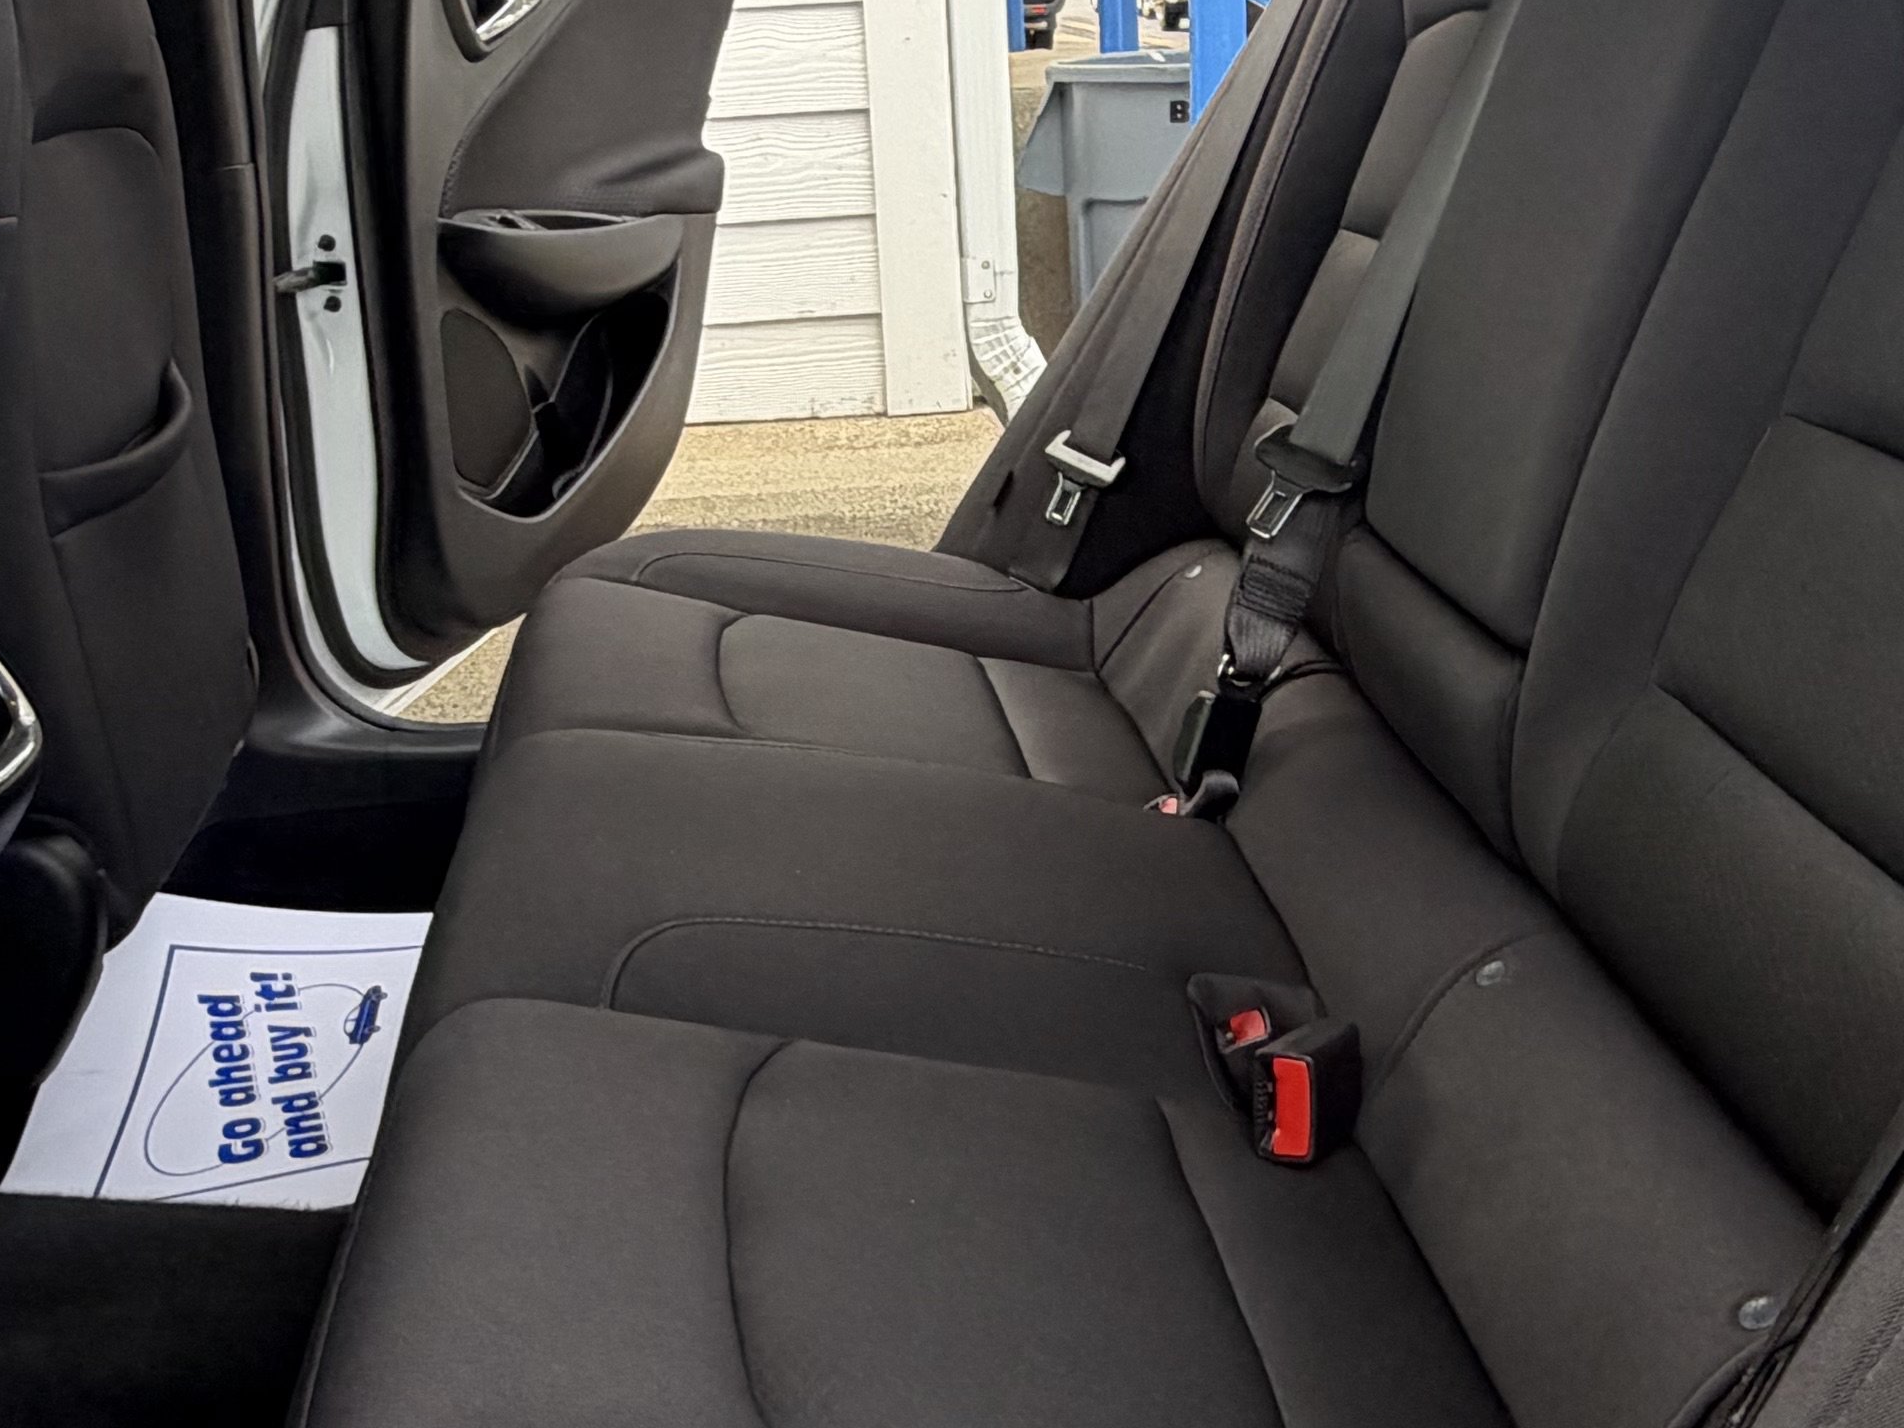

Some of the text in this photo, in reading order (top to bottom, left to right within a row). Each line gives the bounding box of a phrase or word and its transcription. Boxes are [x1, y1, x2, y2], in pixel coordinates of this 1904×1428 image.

[1169, 100, 1190, 124] B
[197, 994, 269, 1164] Go ahead
[249, 971, 333, 1159] and buy it!
